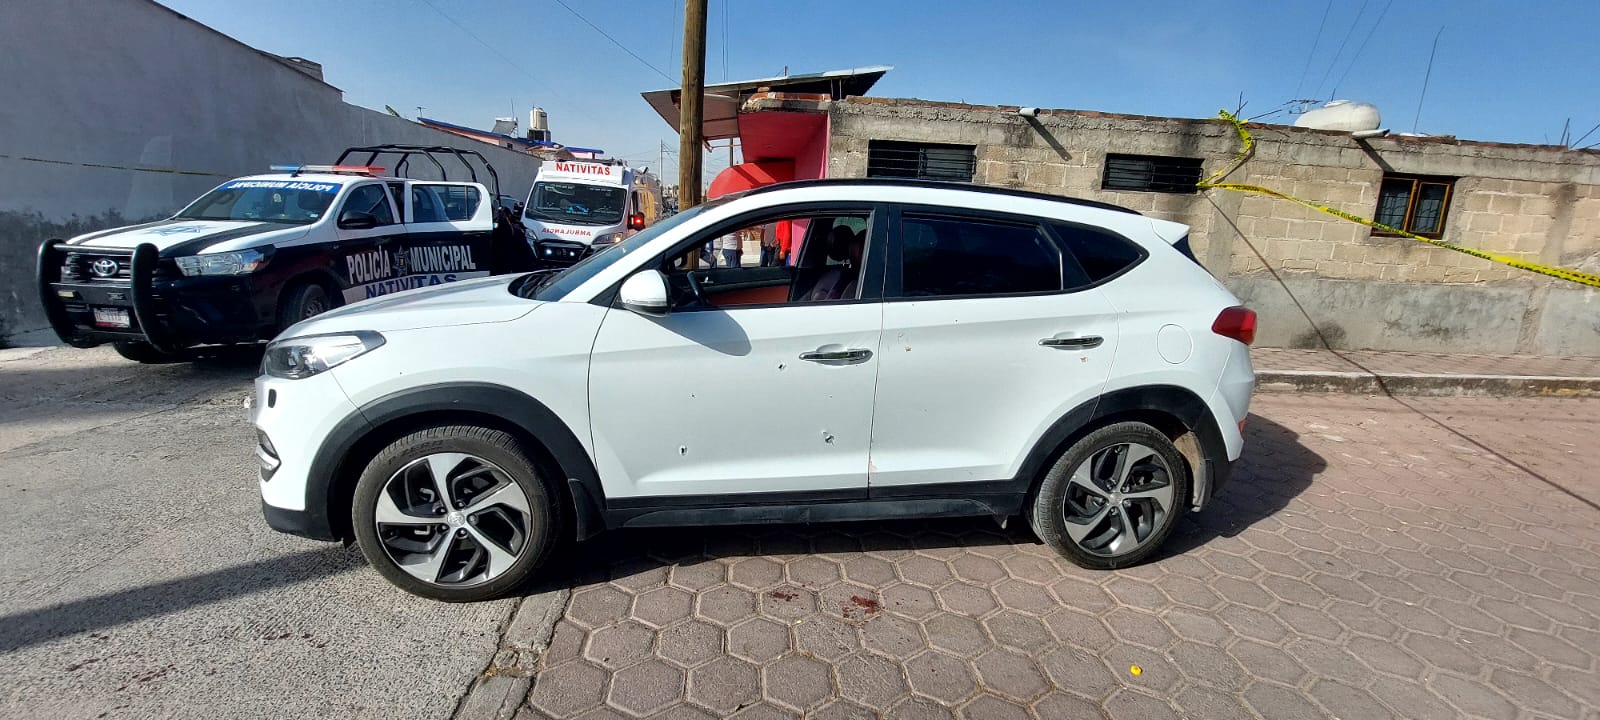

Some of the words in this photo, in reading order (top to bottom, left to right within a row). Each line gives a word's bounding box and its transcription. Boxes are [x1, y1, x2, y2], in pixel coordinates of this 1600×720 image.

[556, 162, 611, 176] NATIVITAS
[346, 245, 391, 284] POLICÍA
[410, 245, 476, 272] MUNICIPAL
[365, 274, 457, 299] NATIVITAS
